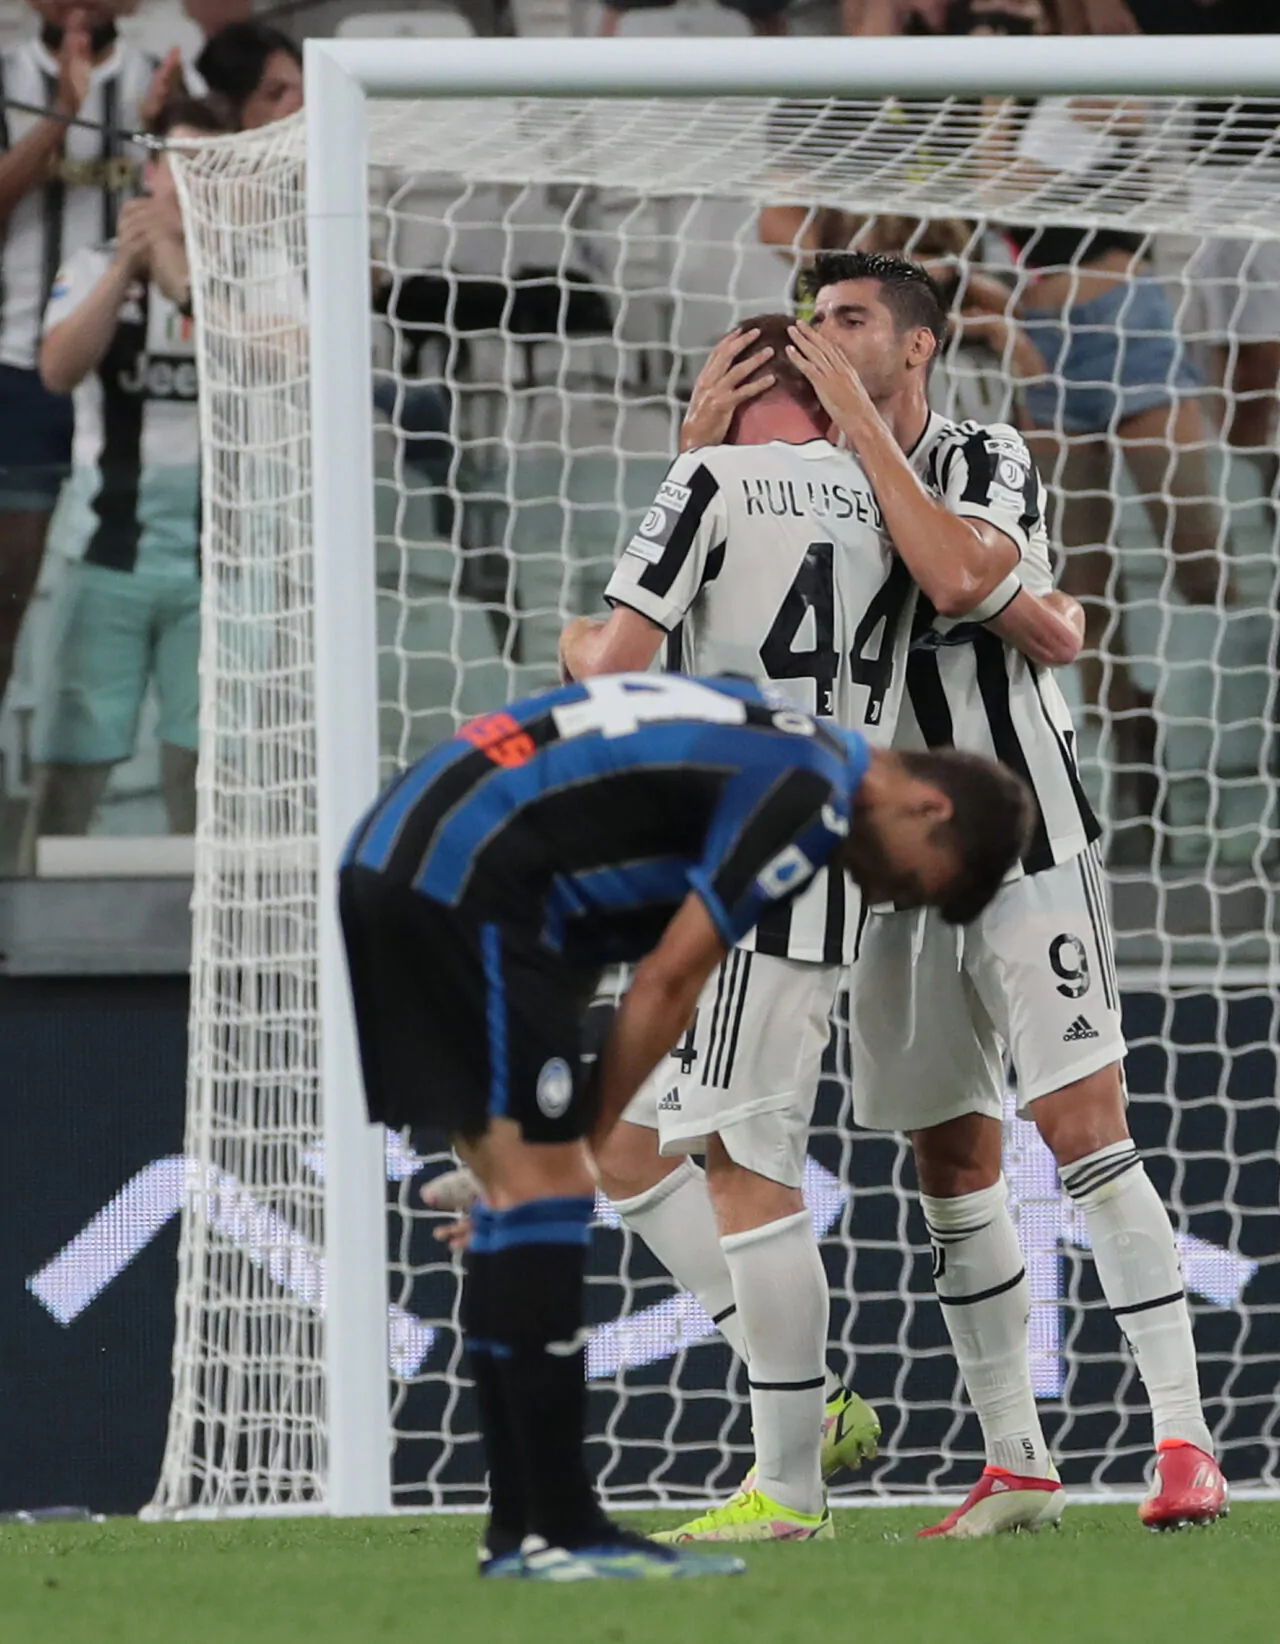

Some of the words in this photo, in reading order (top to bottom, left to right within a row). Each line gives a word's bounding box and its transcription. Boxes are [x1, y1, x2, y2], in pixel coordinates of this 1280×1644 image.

[759, 541, 914, 727] 44
[1048, 932, 1091, 999] 9
[1062, 1030, 1099, 1042] adidas
